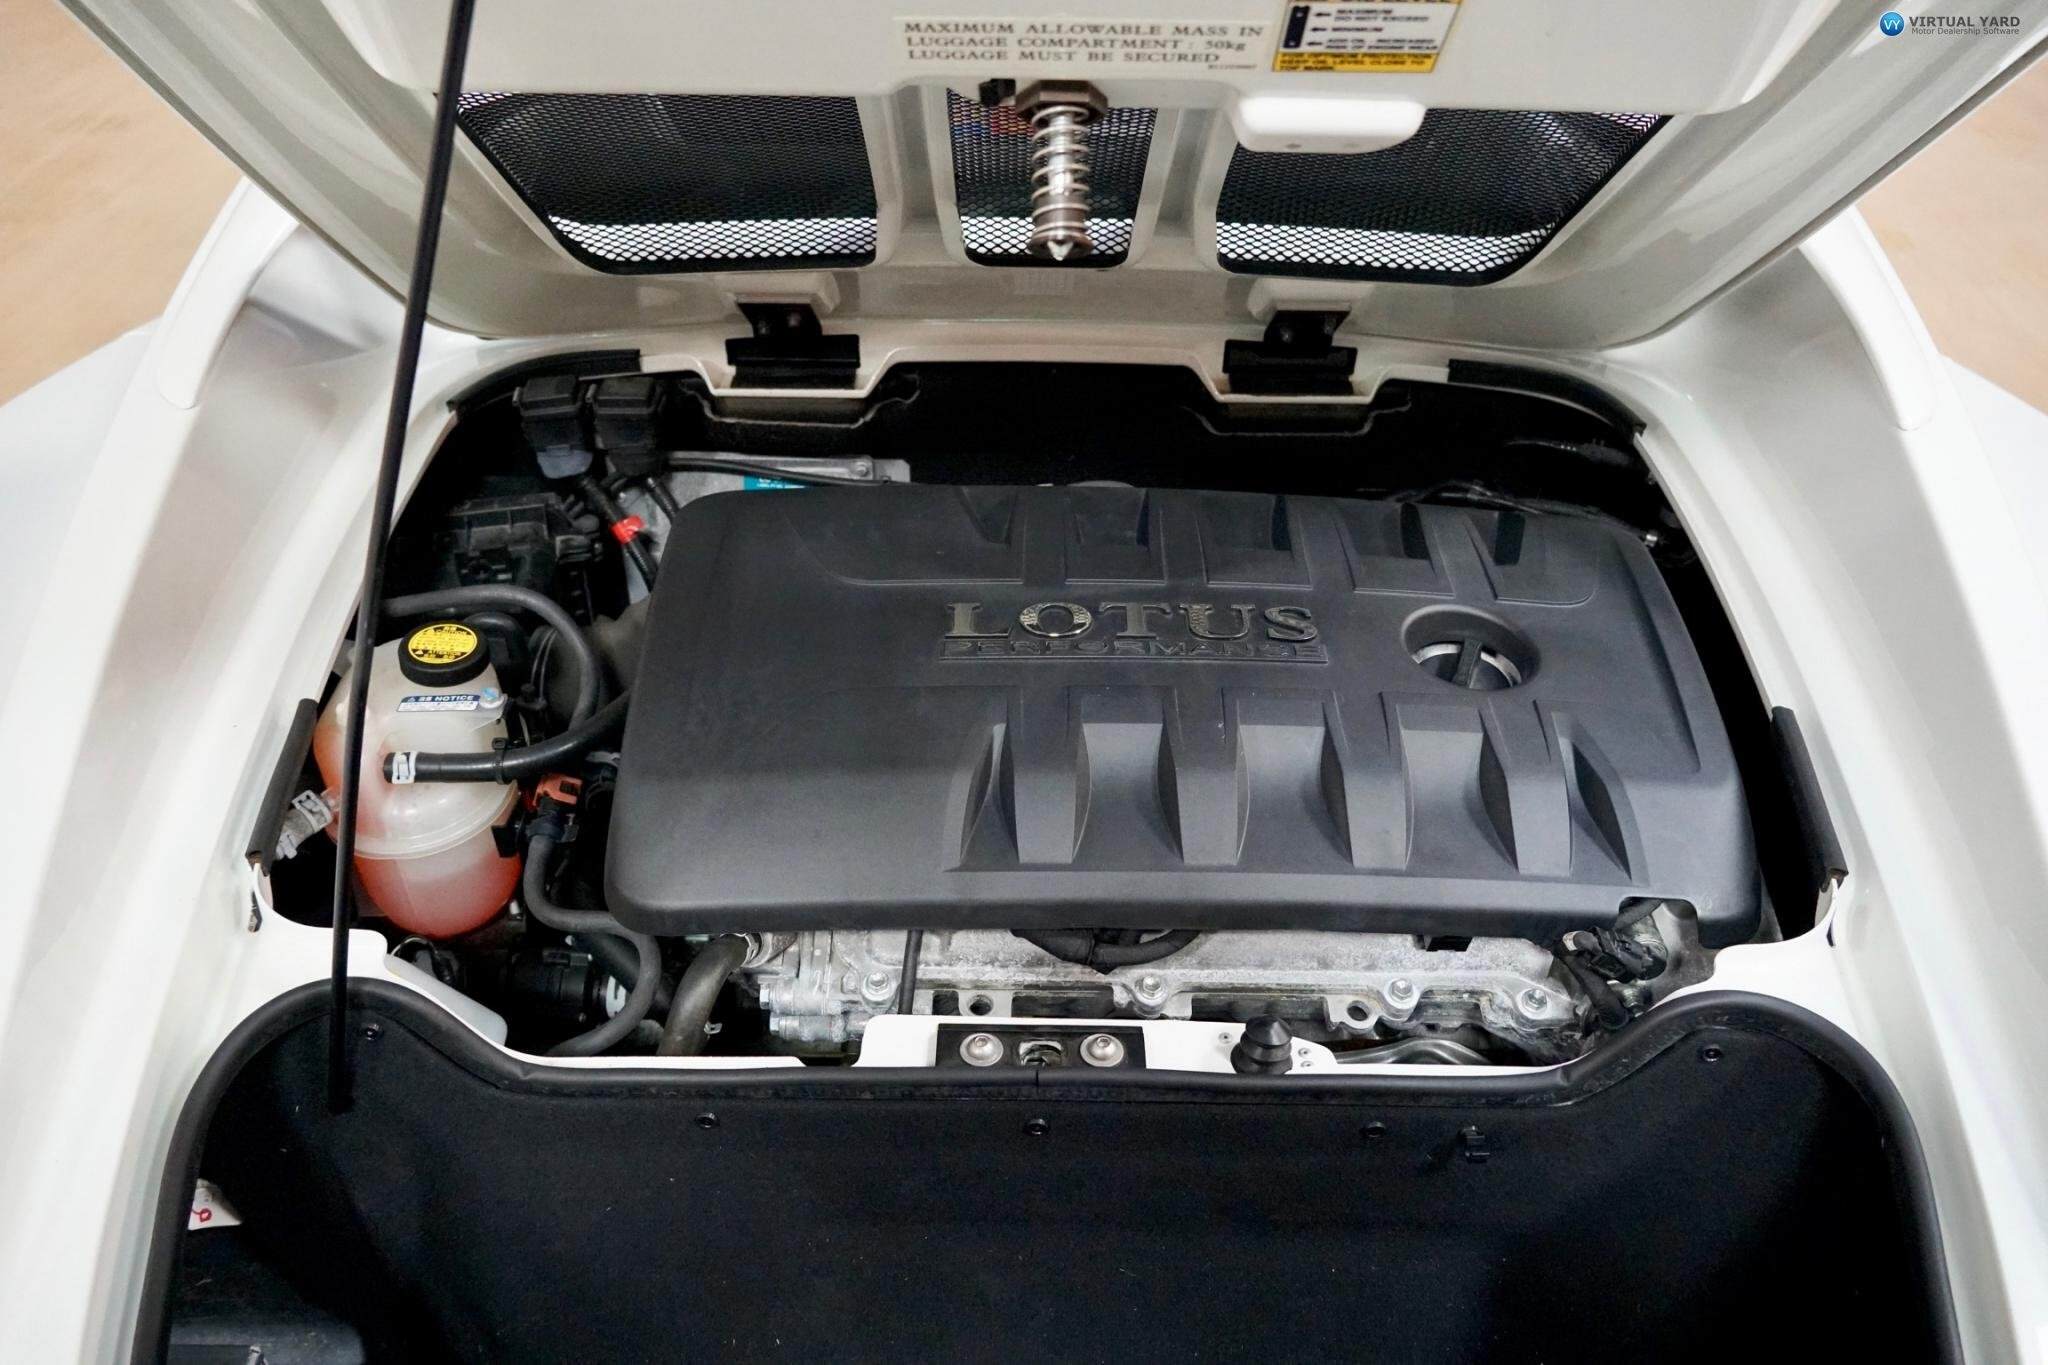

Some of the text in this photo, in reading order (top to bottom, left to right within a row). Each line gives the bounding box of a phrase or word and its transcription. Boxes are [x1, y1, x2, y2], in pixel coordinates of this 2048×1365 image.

[904, 22, 1265, 37] MAXIMUM ALLOWABLE MASS IN
[906, 36, 1009, 48] LUGGAGE
[1017, 37, 1183, 50] COMPARTMENT
[1204, 39, 1247, 51] 50kg
[908, 50, 1220, 64] LUGGAGE MUST BE SECURED
[944, 601, 1319, 643] LOTUS
[944, 640, 1328, 659] PERFORMANCE
